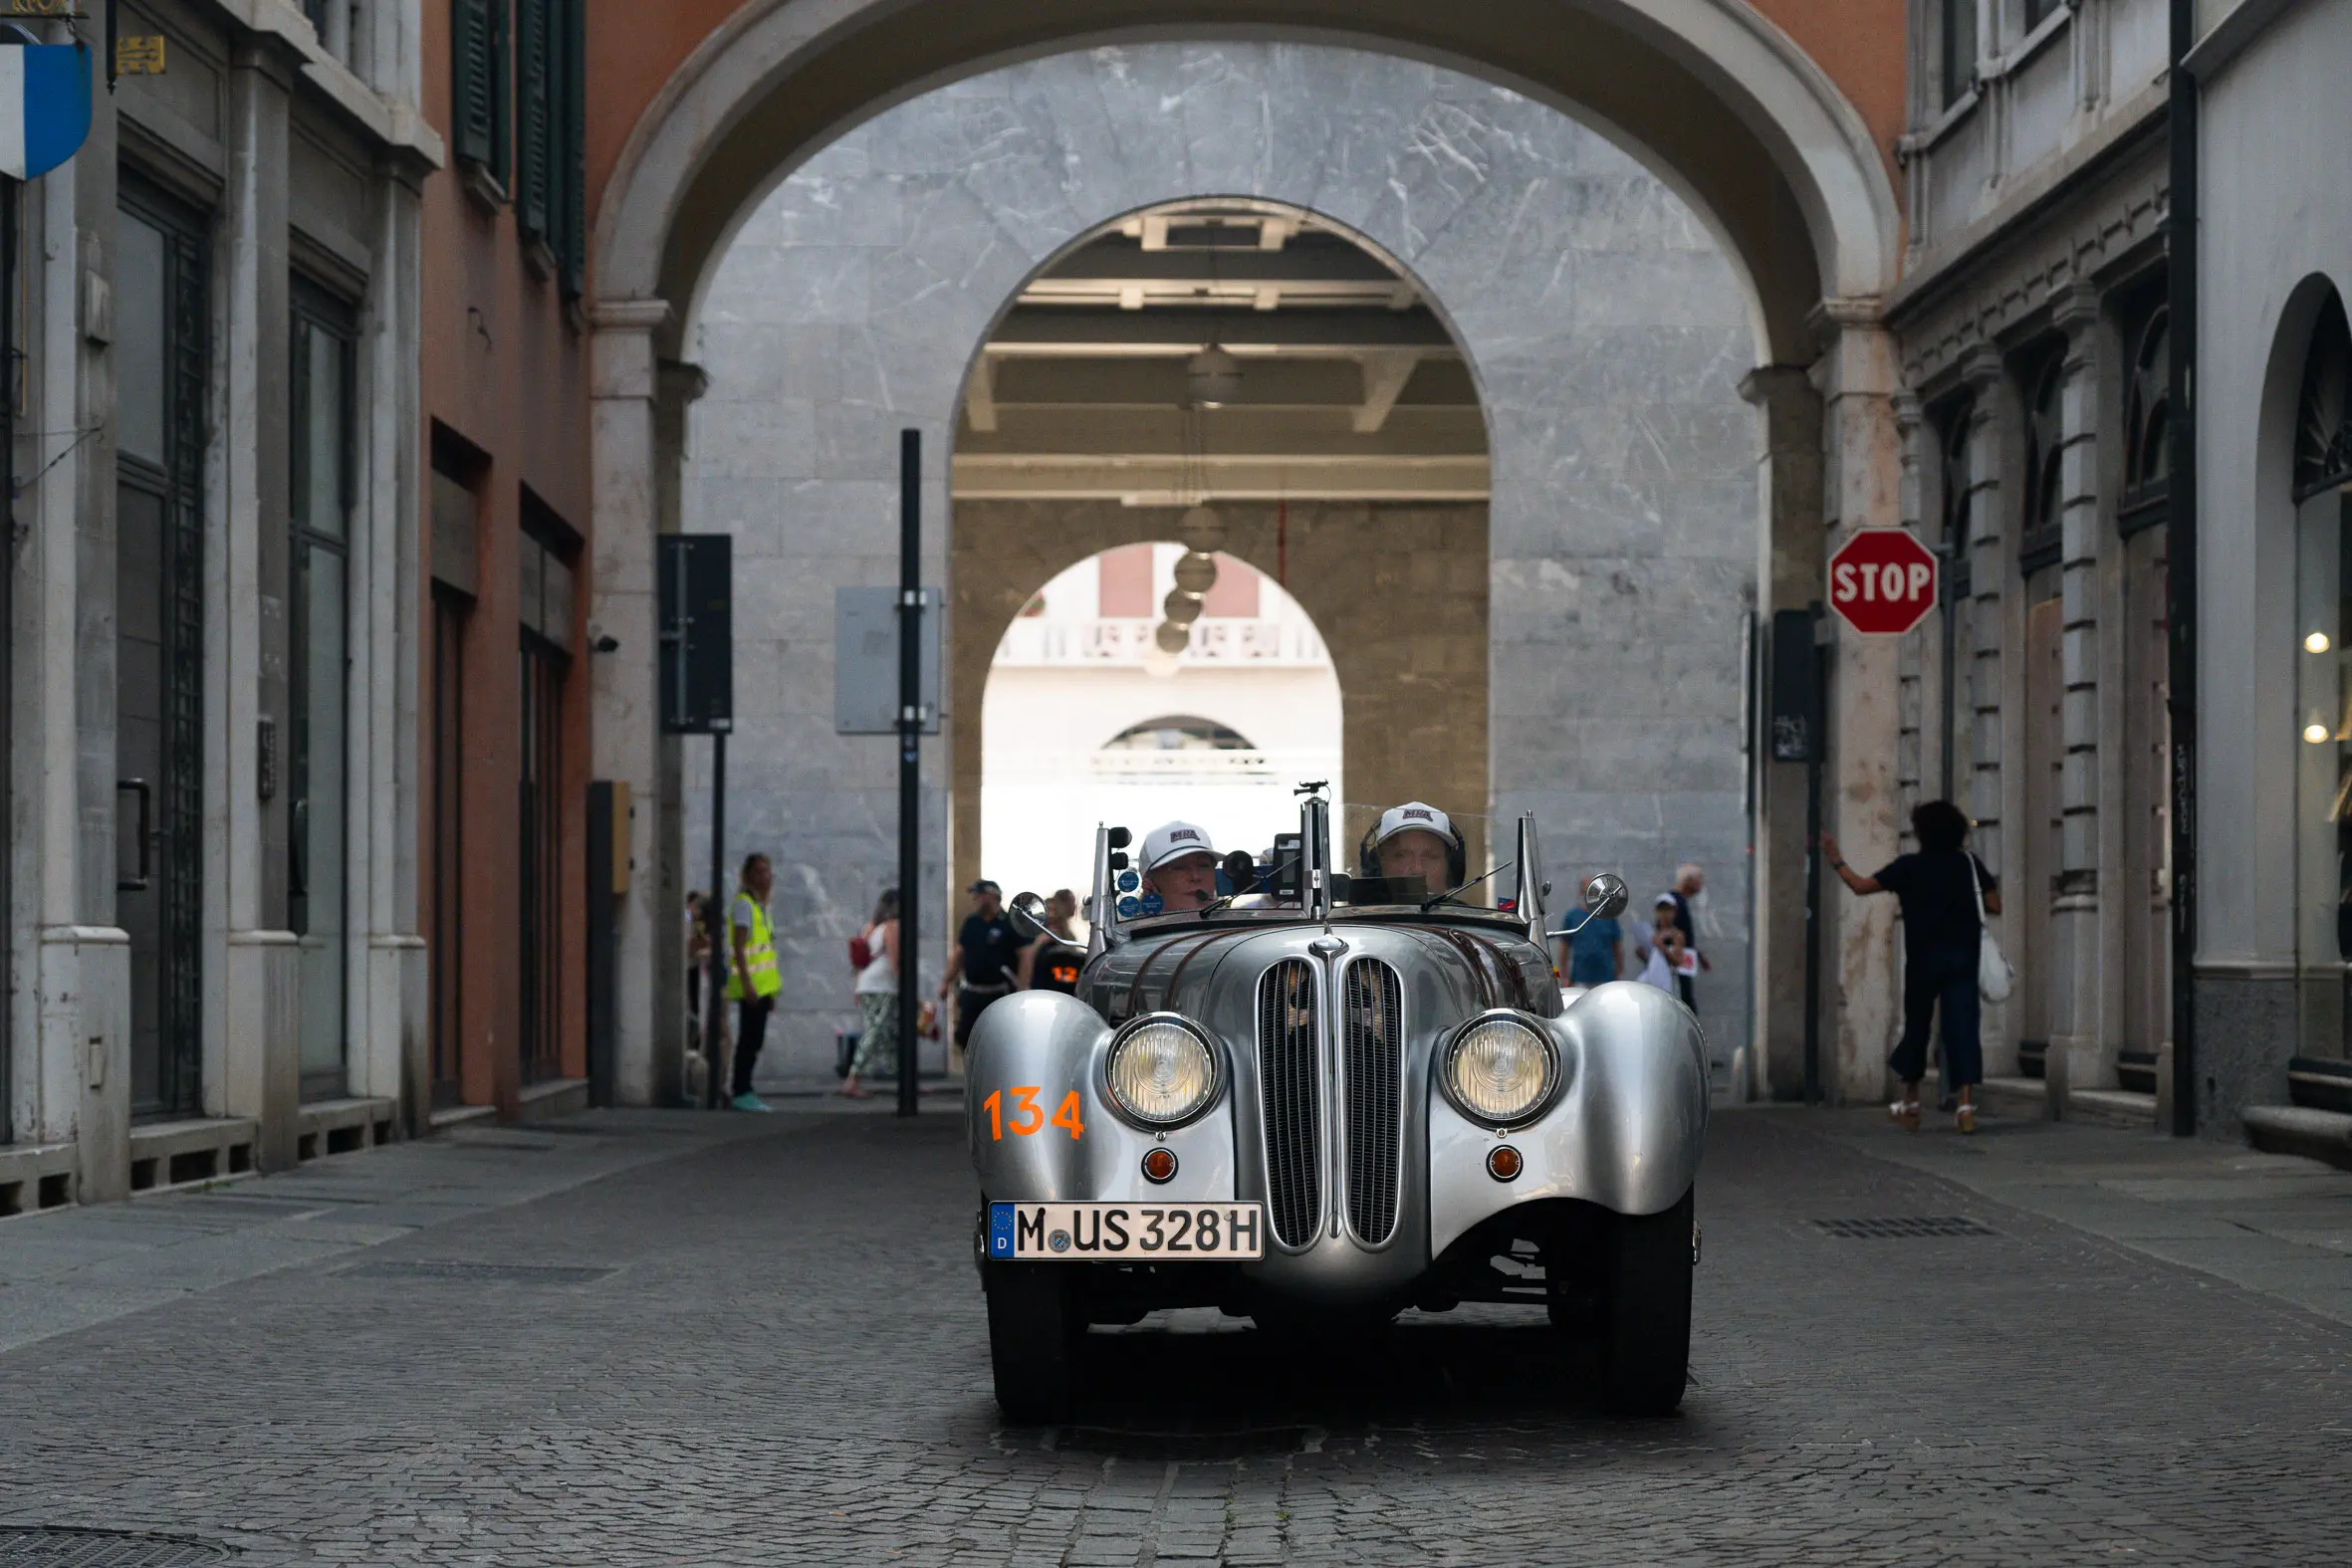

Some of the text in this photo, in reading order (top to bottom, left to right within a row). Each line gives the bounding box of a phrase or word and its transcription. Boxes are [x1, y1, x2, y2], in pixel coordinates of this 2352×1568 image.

[1834, 561, 1932, 602] STOP
[983, 1085, 1084, 1141] 134
[997, 1236, 1007, 1249] D
